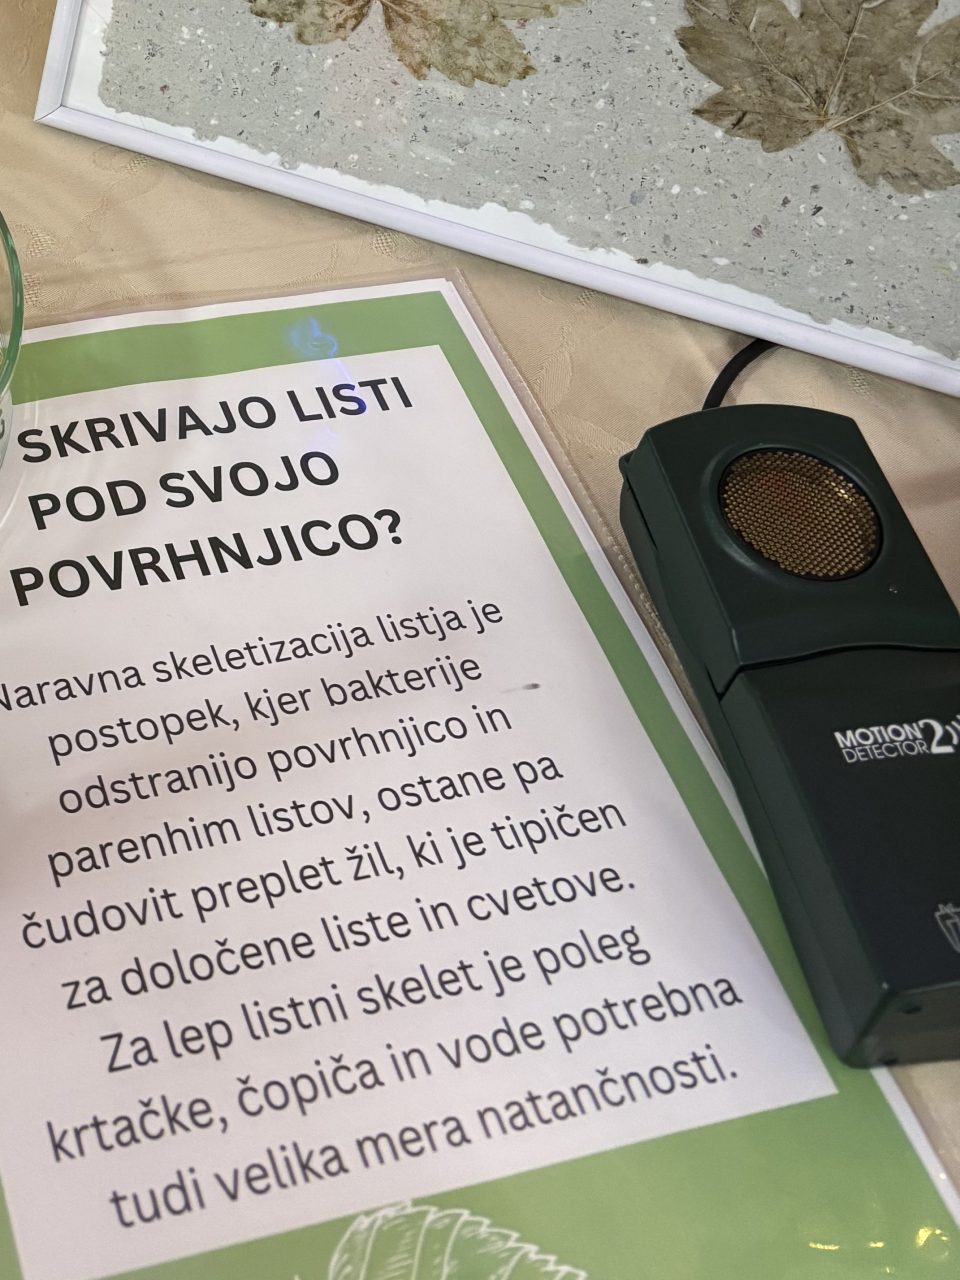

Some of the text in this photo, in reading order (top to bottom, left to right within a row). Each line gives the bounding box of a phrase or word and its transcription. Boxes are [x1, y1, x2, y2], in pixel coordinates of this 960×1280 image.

[18, 396, 276, 463] SKRIVAJO
[286, 377, 413, 422] LISTI
[28, 451, 339, 530] POD SVOJO
[10, 509, 402, 606] POVRHNJICO?
[153, 623, 375, 682] skeletizacija
[377, 606, 467, 643] listja
[469, 600, 503, 635] je
[48, 655, 482, 766] postopek, kjer bakterije
[59, 705, 512, 813] odstranijo povrhnjico in
[834, 722, 923, 749] MOTION
[842, 739, 930, 764] DETECTOR
[22, 804, 627, 949] čudovit preplet žil, ki je tipičen
[48, 757, 564, 888] parenhim listov, ostane pa
[61, 868, 635, 1010] za določene liste in cvetove.
[99, 925, 651, 1073] Za lep listni skelet je poleg
[46, 978, 744, 1163] krtačke, čopiča in vode potrebna
[109, 1043, 738, 1228] tudi velika mera natančnosti.
